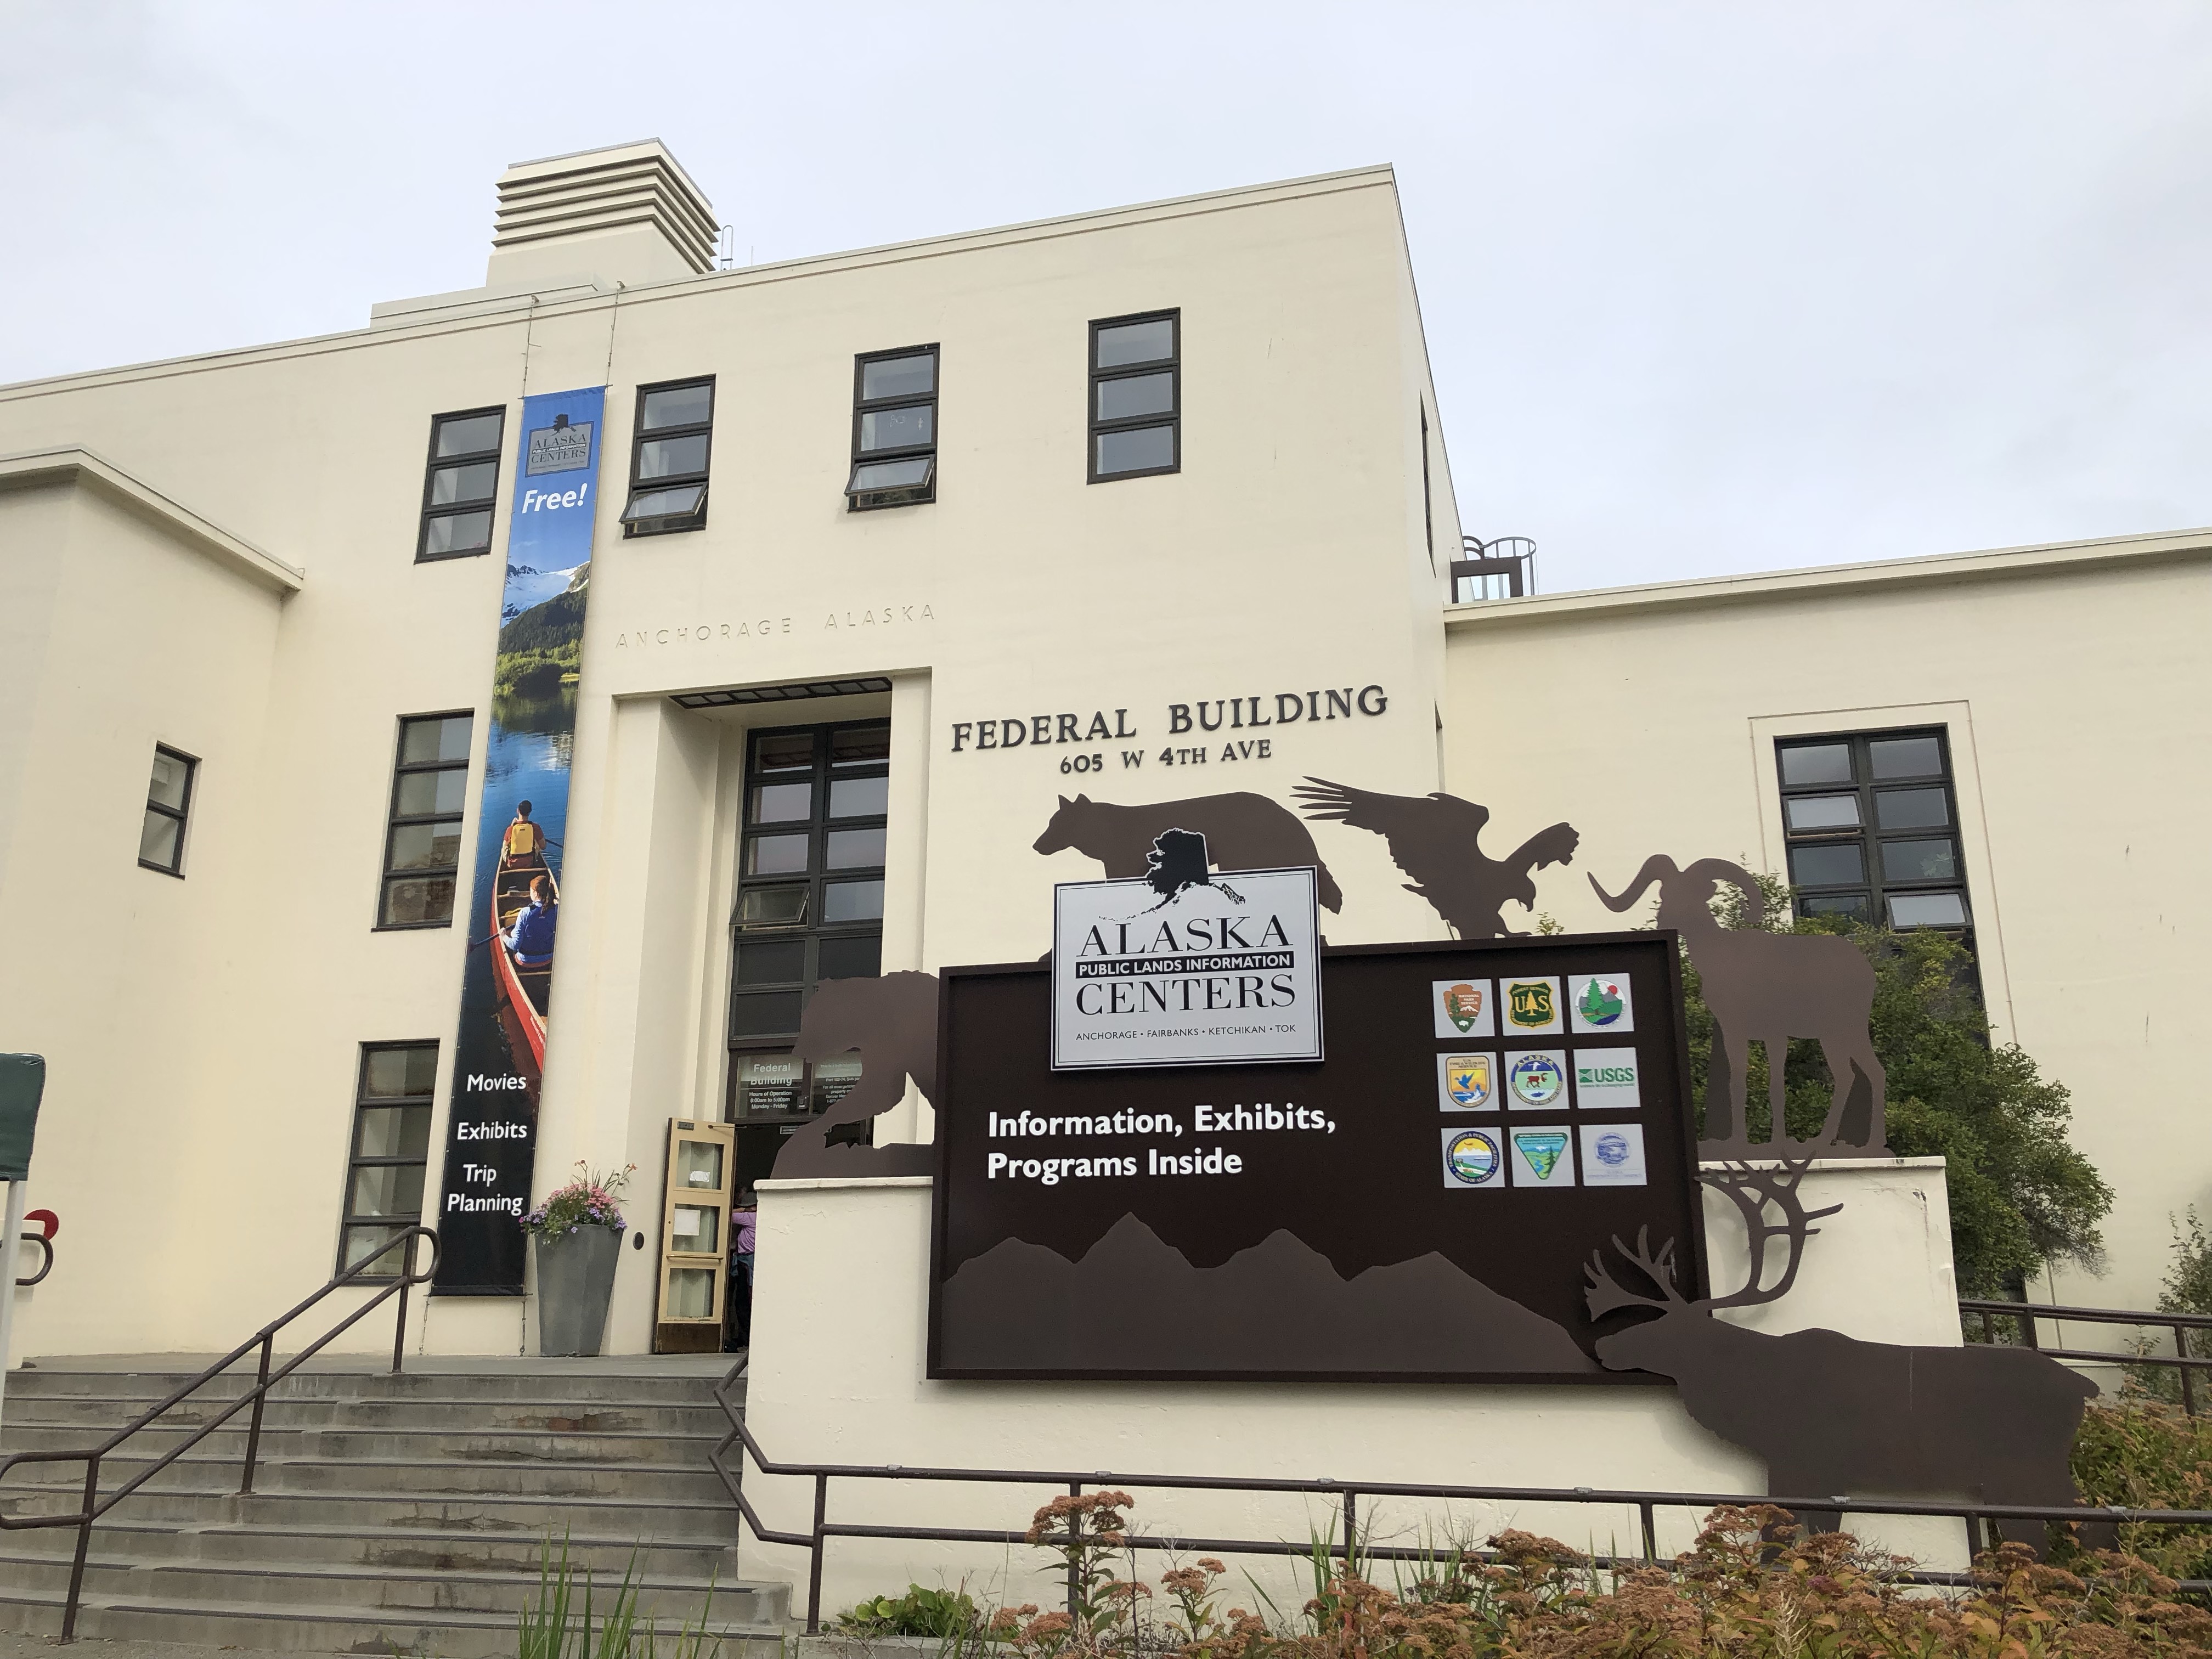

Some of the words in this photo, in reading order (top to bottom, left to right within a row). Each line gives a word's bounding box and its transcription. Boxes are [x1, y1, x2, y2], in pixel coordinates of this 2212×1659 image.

[535, 434, 586, 448] ALASKA
[532, 449, 586, 463] CENTERS
[522, 483, 588, 514] Free!
[616, 618, 792, 648] ANCHORAGE
[825, 605, 934, 629] ALASKA
[951, 708, 1136, 752] FEDERAL
[1168, 684, 1388, 734] BUILDING
[1060, 753, 1103, 774] 605
[1121, 749, 1144, 769] W
[1159, 747, 1207, 766] 4TH
[1221, 739, 1272, 761] AVE
[1076, 915, 1294, 957] ALASKA
[1079, 962, 1130, 976] PUBLIC
[1134, 959, 1182, 973] LANDS
[1186, 955, 1290, 971] INFORMATION
[1076, 974, 1295, 1015] CENTERS
[1076, 1030, 1137, 1040] ANCHORAGE
[1147, 1028, 1199, 1038] FAIRBANKS
[1209, 1025, 1266, 1035] KETCHIKAN
[1276, 1024, 1296, 1032] TOK
[754, 1063, 791, 1073] Federal
[1517, 1054, 1554, 1066] ALASKA
[467, 1073, 527, 1092] Movies
[751, 1075, 792, 1086] Building
[1594, 1067, 1634, 1082] USGS
[457, 1121, 527, 1140] Exhibits
[989, 1107, 1183, 1137] Information,
[1194, 1103, 1336, 1134] Exhibits,
[463, 1164, 496, 1187] Trip
[988, 1152, 1137, 1186] Programs
[1149, 1147, 1243, 1175] Inside
[447, 1193, 523, 1216] Planning
